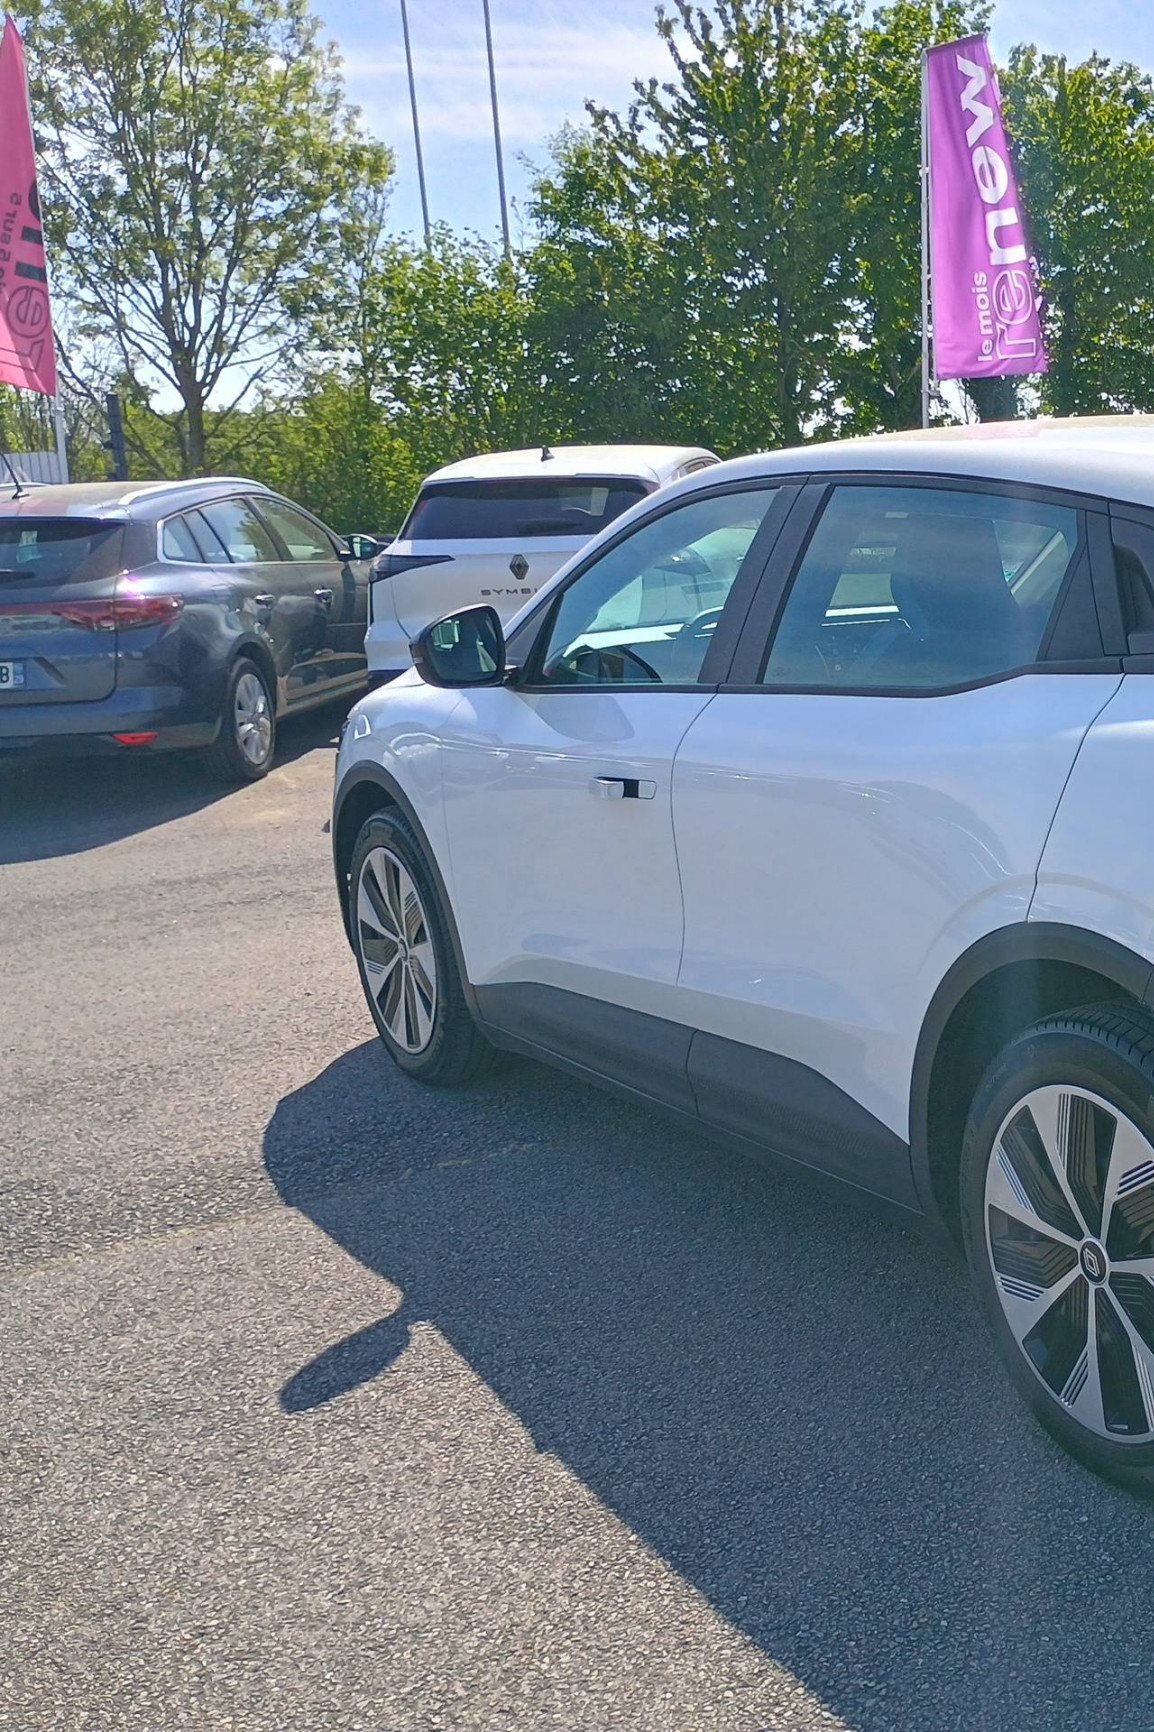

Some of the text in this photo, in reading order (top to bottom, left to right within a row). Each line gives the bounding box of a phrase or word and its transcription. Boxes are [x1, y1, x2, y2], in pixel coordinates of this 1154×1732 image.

[956, 54, 1036, 359] renew
[971, 271, 994, 362] le mois
[0, 665, 10, 684] B
